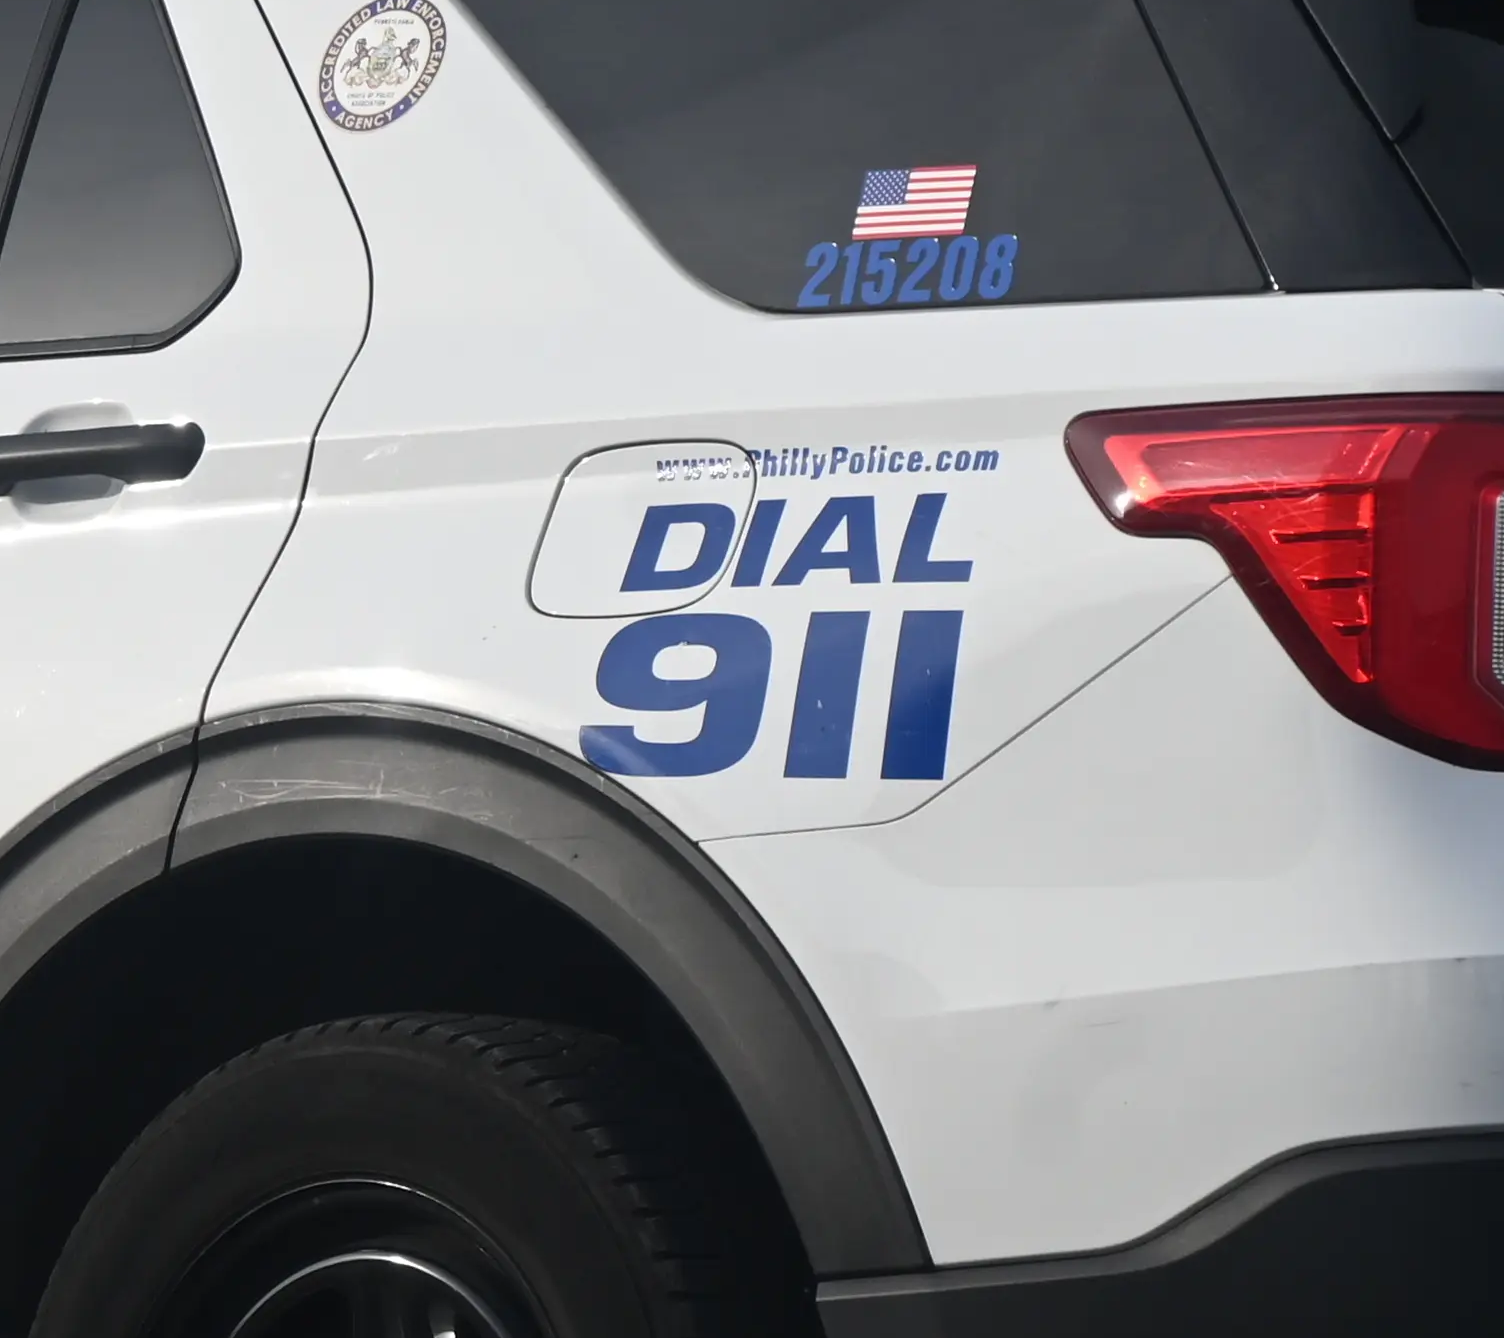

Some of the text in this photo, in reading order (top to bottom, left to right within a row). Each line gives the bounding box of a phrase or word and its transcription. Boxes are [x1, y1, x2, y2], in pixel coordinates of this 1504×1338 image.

[321, 10, 371, 102] ACCREDITED
[411, 0, 445, 104] ENFORCEMENT
[334, 109, 393, 129] AGENCY
[796, 234, 1019, 308] 215208
[619, 493, 974, 592] DIAL
[578, 610, 964, 780] 911
